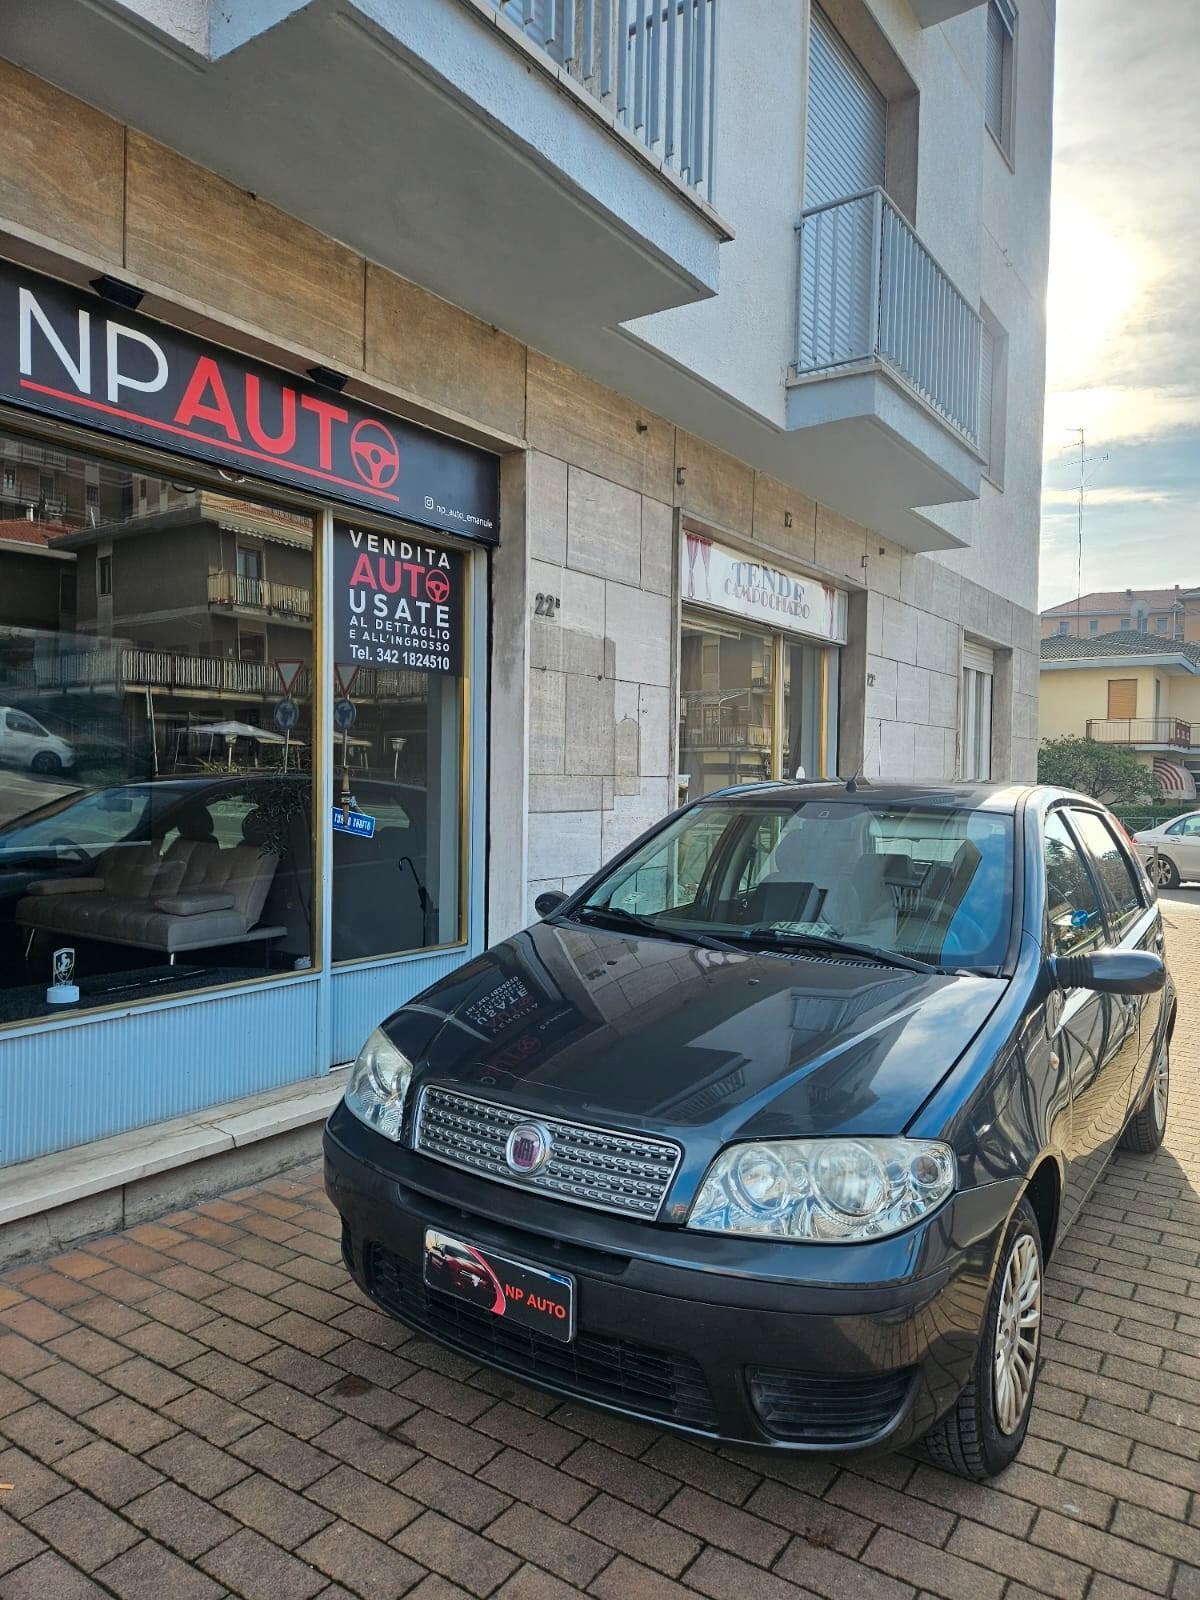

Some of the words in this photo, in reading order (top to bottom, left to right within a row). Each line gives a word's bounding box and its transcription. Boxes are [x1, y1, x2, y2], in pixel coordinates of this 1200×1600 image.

[349, 529, 451, 570] VENDITA
[349, 552, 450, 604] AUTO
[349, 588, 450, 628] USATE
[349, 615, 368, 628] AL
[375, 618, 450, 640] DETTAGLIO
[349, 629, 356, 639] E
[362, 631, 450, 653] ALL'INGROSSO
[349, 644, 373, 661] Tel.
[376, 647, 399, 664] 342
[402, 651, 450, 670] 1824510
[505, 1283, 524, 1301] NP
[526, 1293, 566, 1319] AUTO
